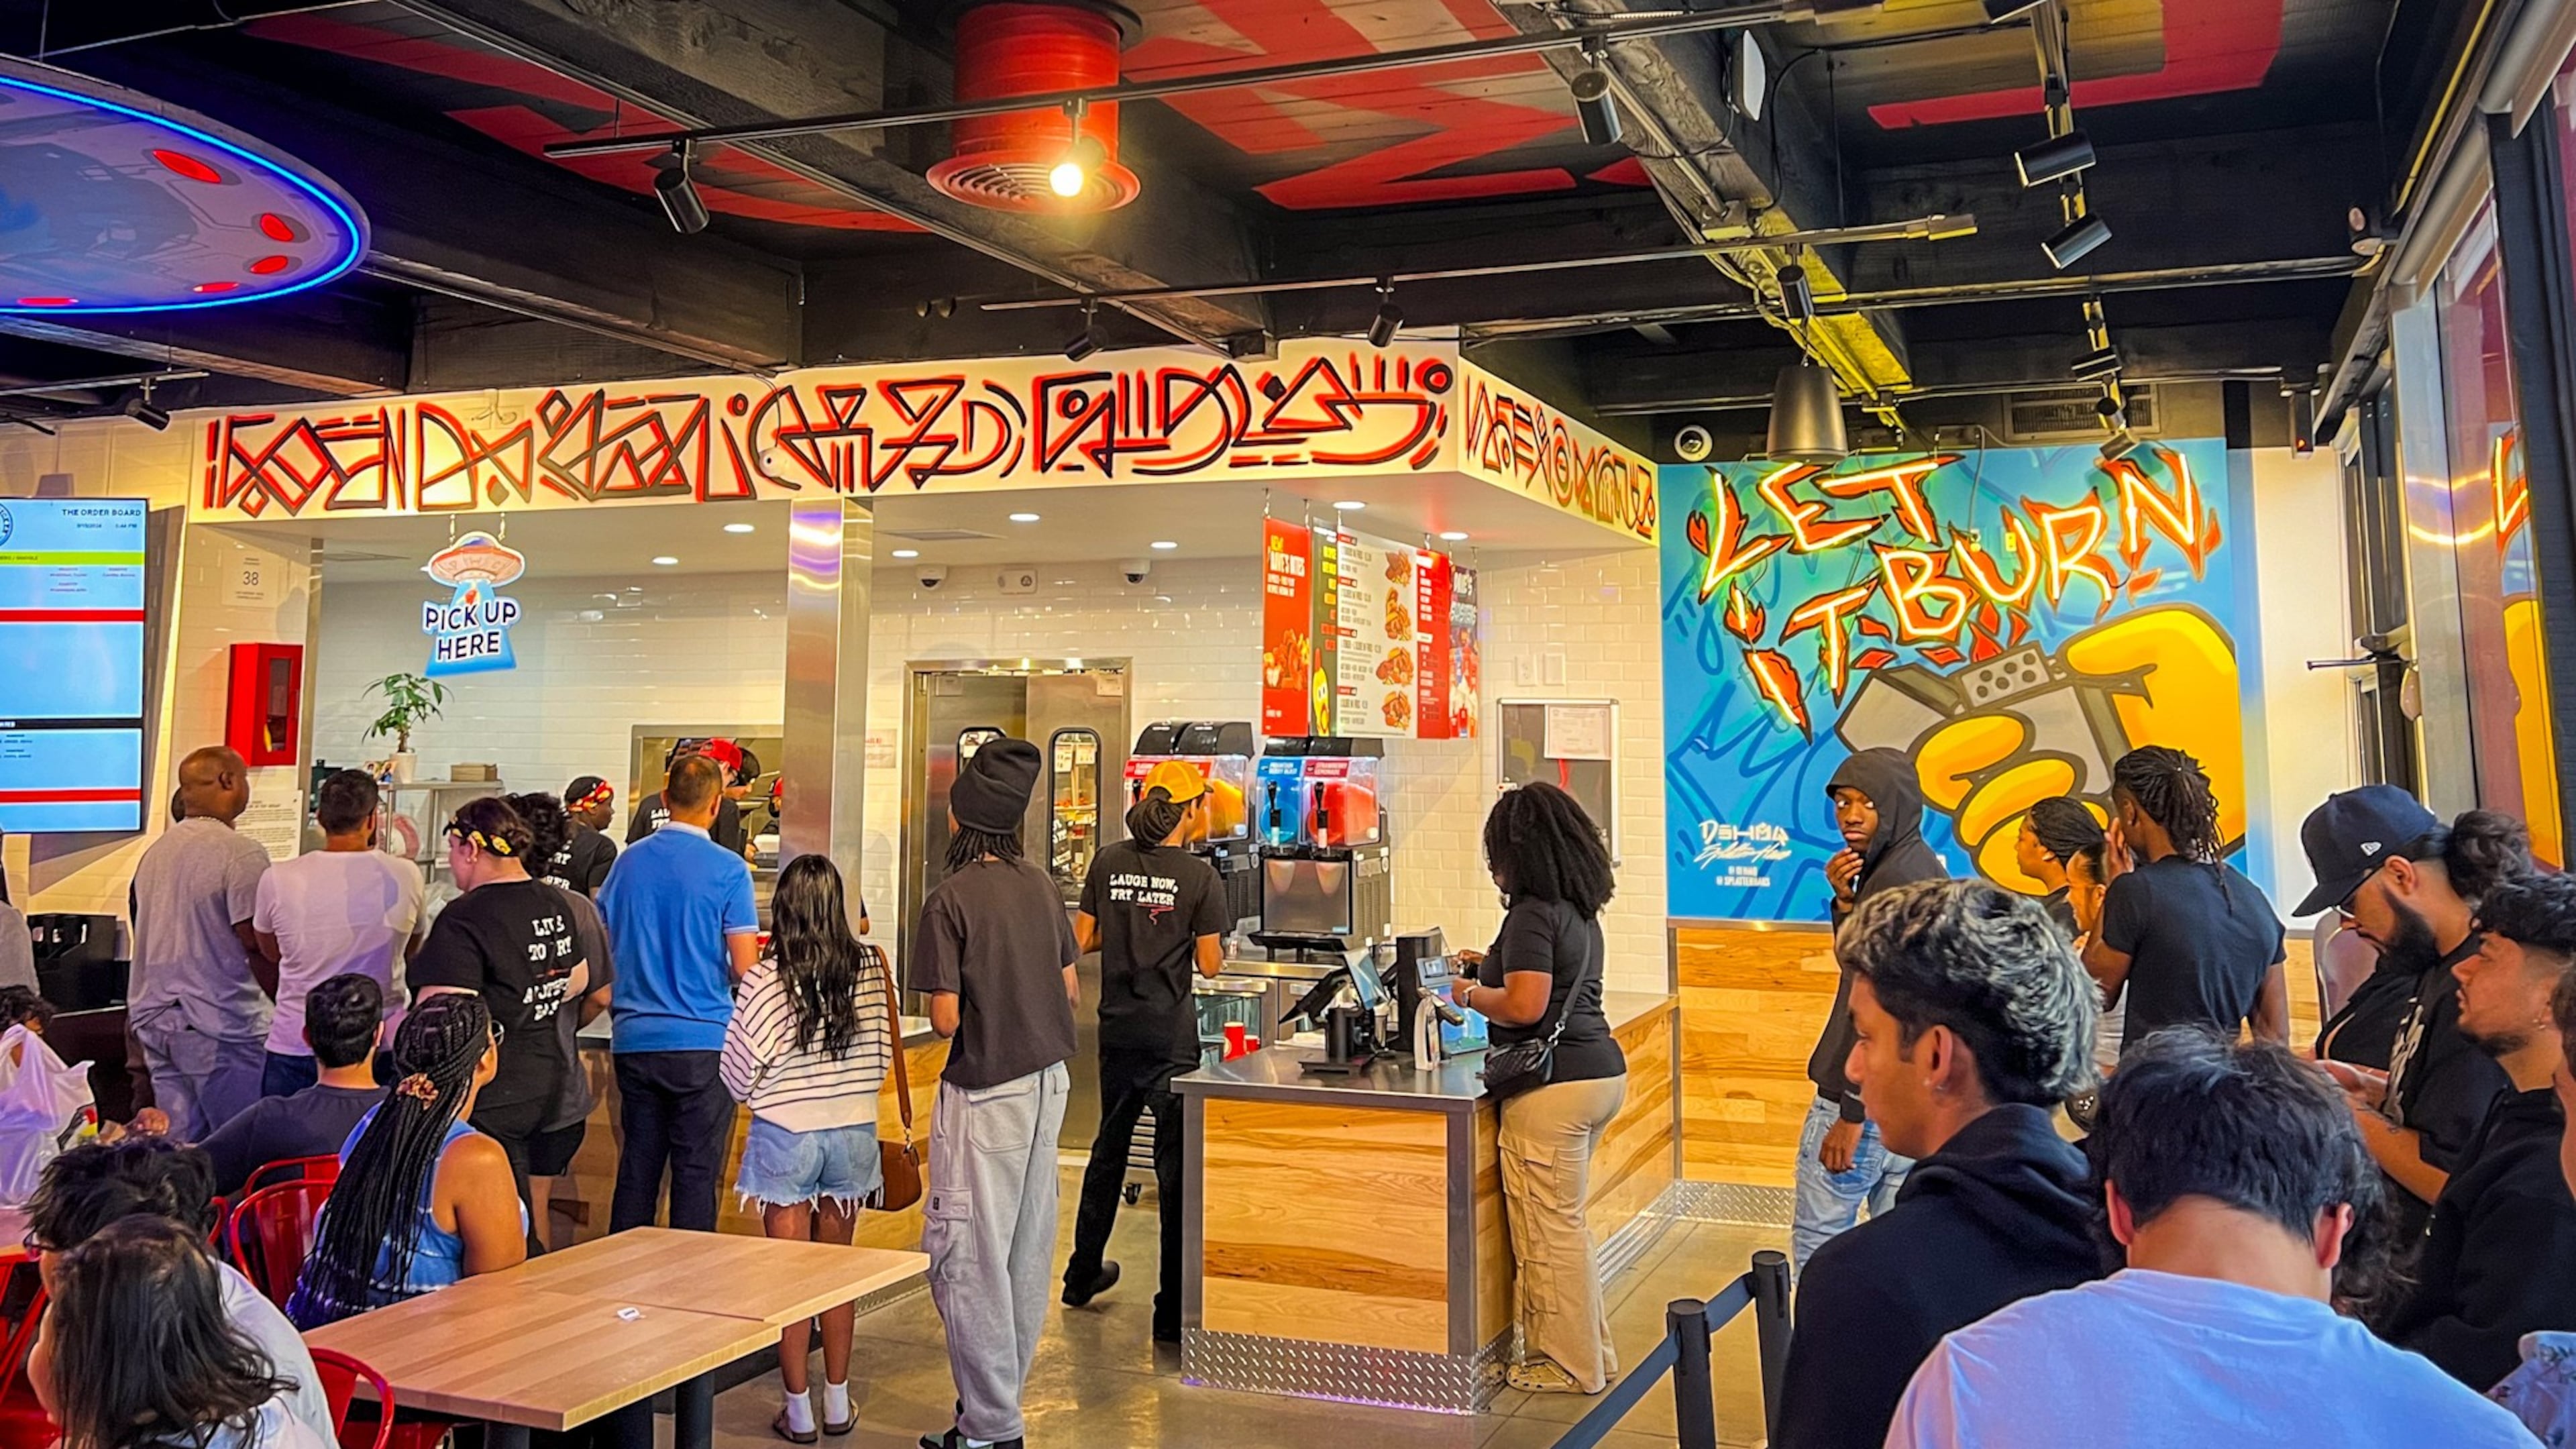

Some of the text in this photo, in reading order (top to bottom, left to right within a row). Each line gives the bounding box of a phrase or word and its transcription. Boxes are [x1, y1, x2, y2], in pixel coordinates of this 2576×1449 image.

[1697, 454, 1966, 604] LET
[1869, 447, 2224, 647] BURN
[243, 571, 259, 586] 38
[425, 602, 517, 630] PICK UP
[437, 631, 500, 660] HERE
[1150, 876, 1179, 894] NOW,
[1110, 888, 1175, 906] FRY LATER
[528, 943, 547, 961] TO
